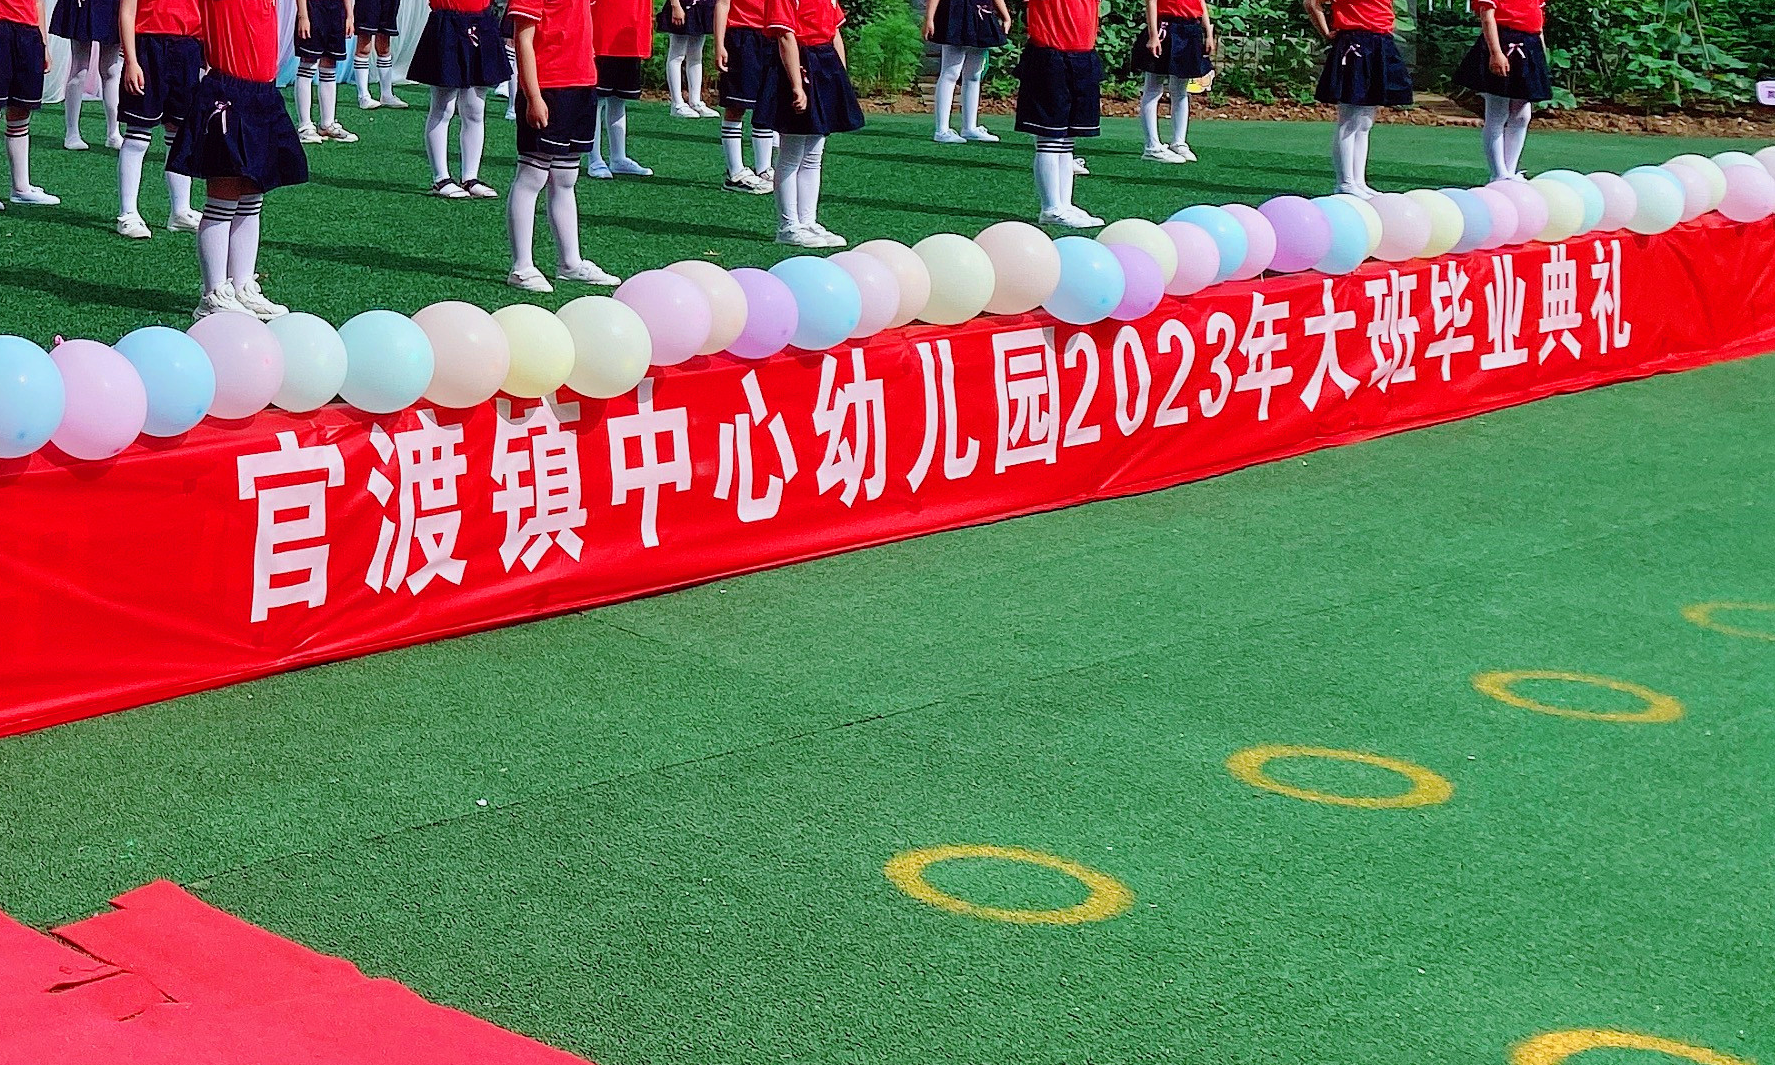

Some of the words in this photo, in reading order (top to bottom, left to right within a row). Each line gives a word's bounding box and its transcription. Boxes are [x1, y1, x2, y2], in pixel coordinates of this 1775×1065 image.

[237, 239, 1630, 622] 官渡镇中心幼儿园2023年大班毕业典礼
